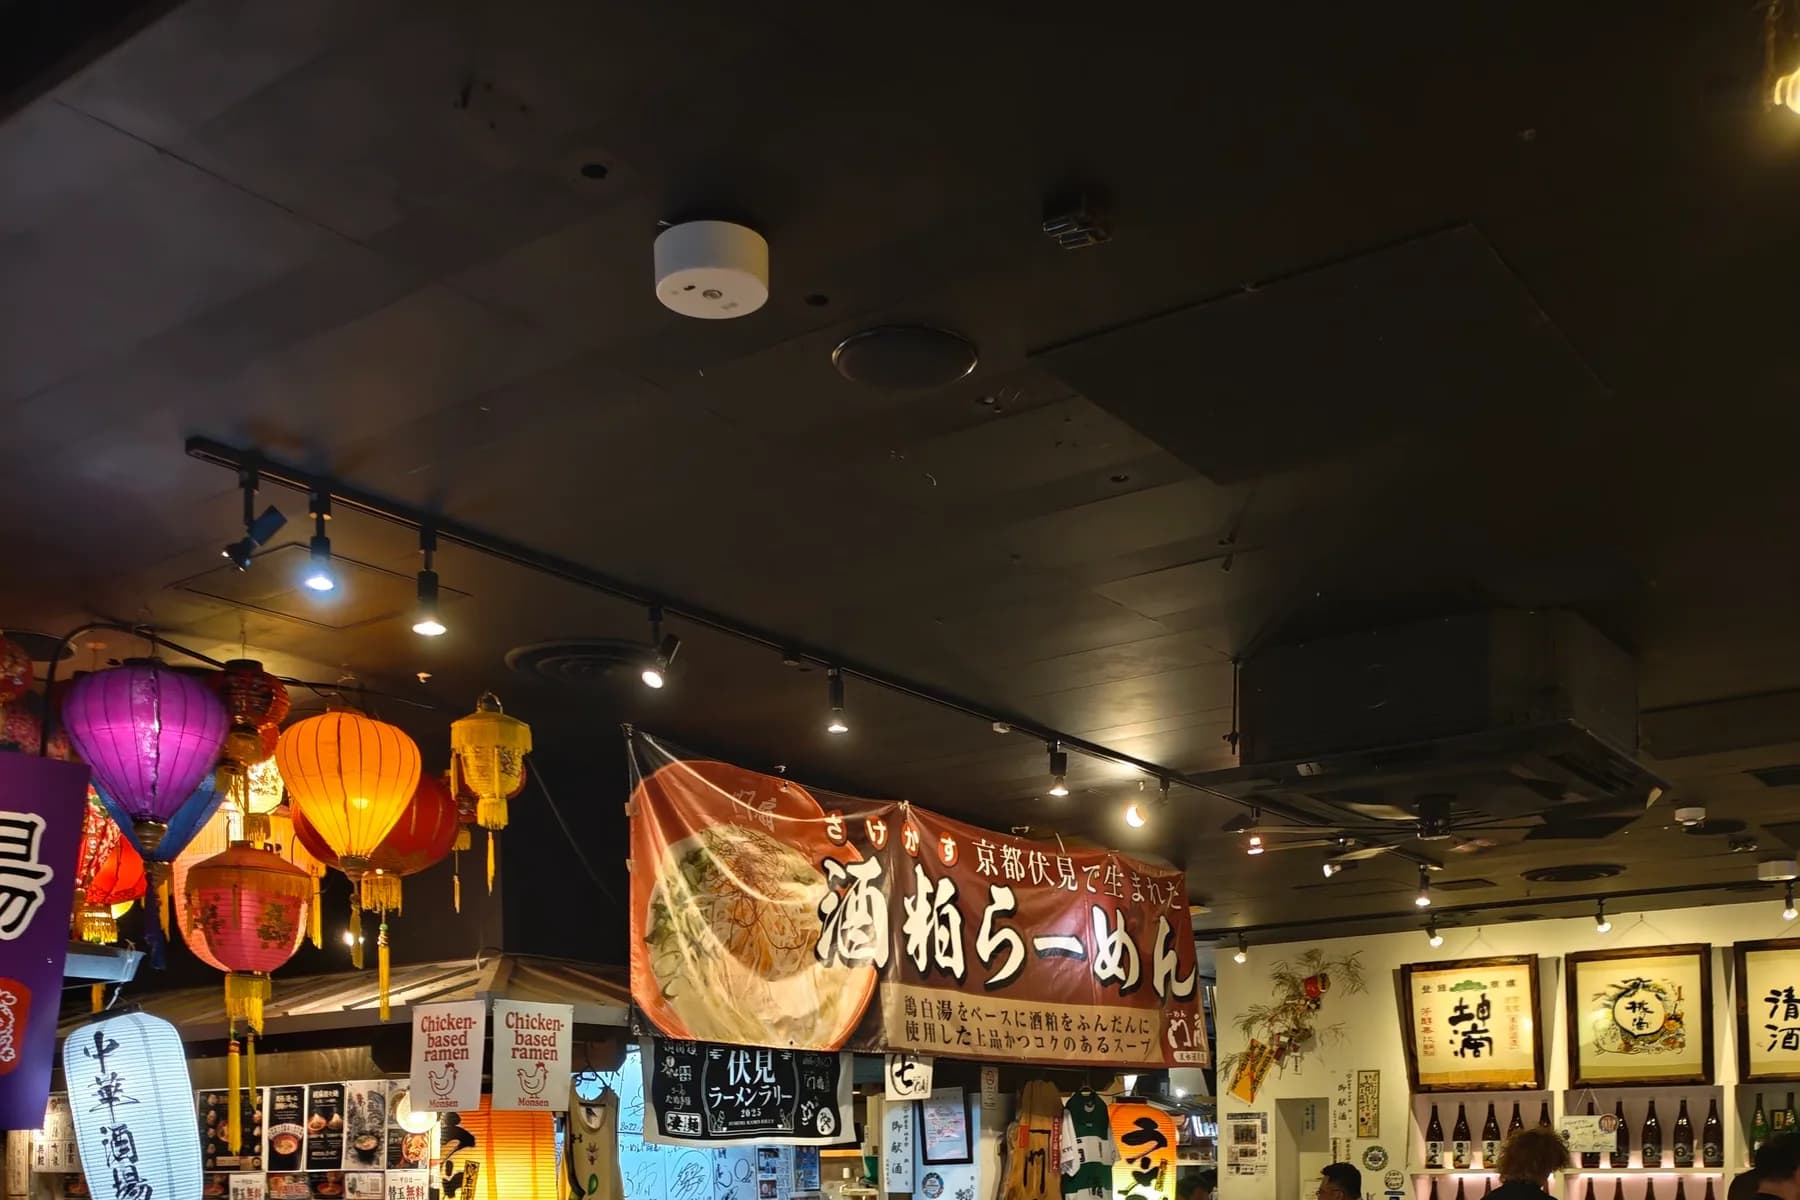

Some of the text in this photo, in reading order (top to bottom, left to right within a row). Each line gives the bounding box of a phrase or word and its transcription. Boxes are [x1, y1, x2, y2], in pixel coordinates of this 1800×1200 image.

[972, 838, 1183, 910] 京都伏見で生まれた
[817, 855, 1196, 999] 酒粕らーめん
[1764, 986, 1800, 1052] 清酒
[427, 1031, 468, 1048] based
[514, 1030, 557, 1048] based
[424, 1047, 469, 1062] ramen
[511, 1047, 558, 1061] ramen
[727, 1050, 776, 1086] 伏見
[518, 1097, 549, 1107] Monsen
[708, 1085, 793, 1109] ラーメンラリー
